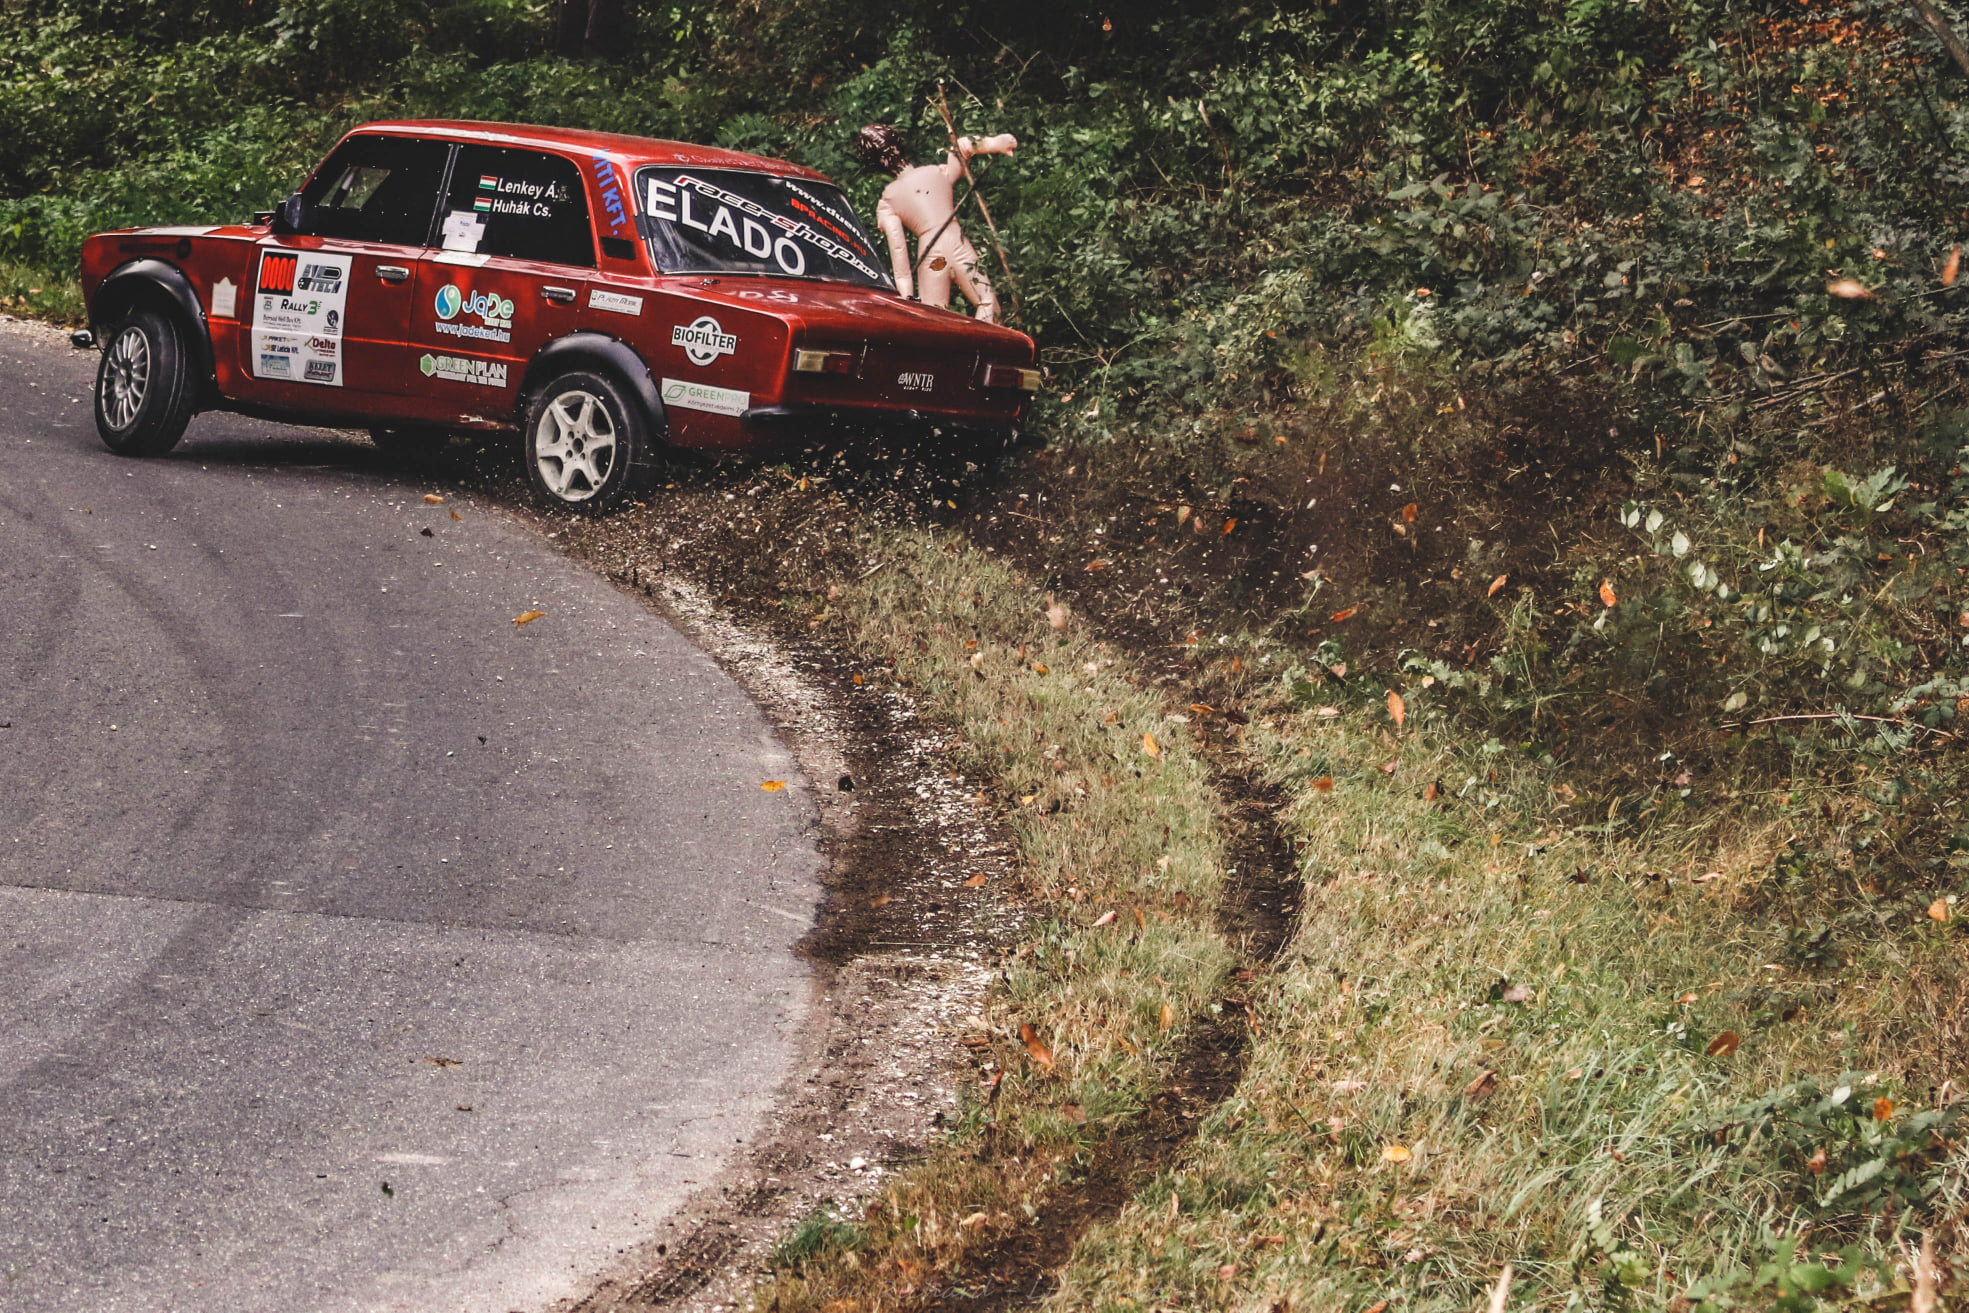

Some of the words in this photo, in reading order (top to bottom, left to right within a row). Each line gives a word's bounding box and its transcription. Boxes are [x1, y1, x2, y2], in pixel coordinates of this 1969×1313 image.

[497, 178, 544, 199] Lenkey
[545, 180, 558, 198] Á.
[493, 199, 530, 215] Huhák
[533, 203, 552, 217] Cs.
[602, 187, 627, 235] KFT.
[435, 322, 511, 343] www.jadekert.hu
[673, 328, 735, 350] BIOFILTER
[313, 338, 336, 349] Delta
